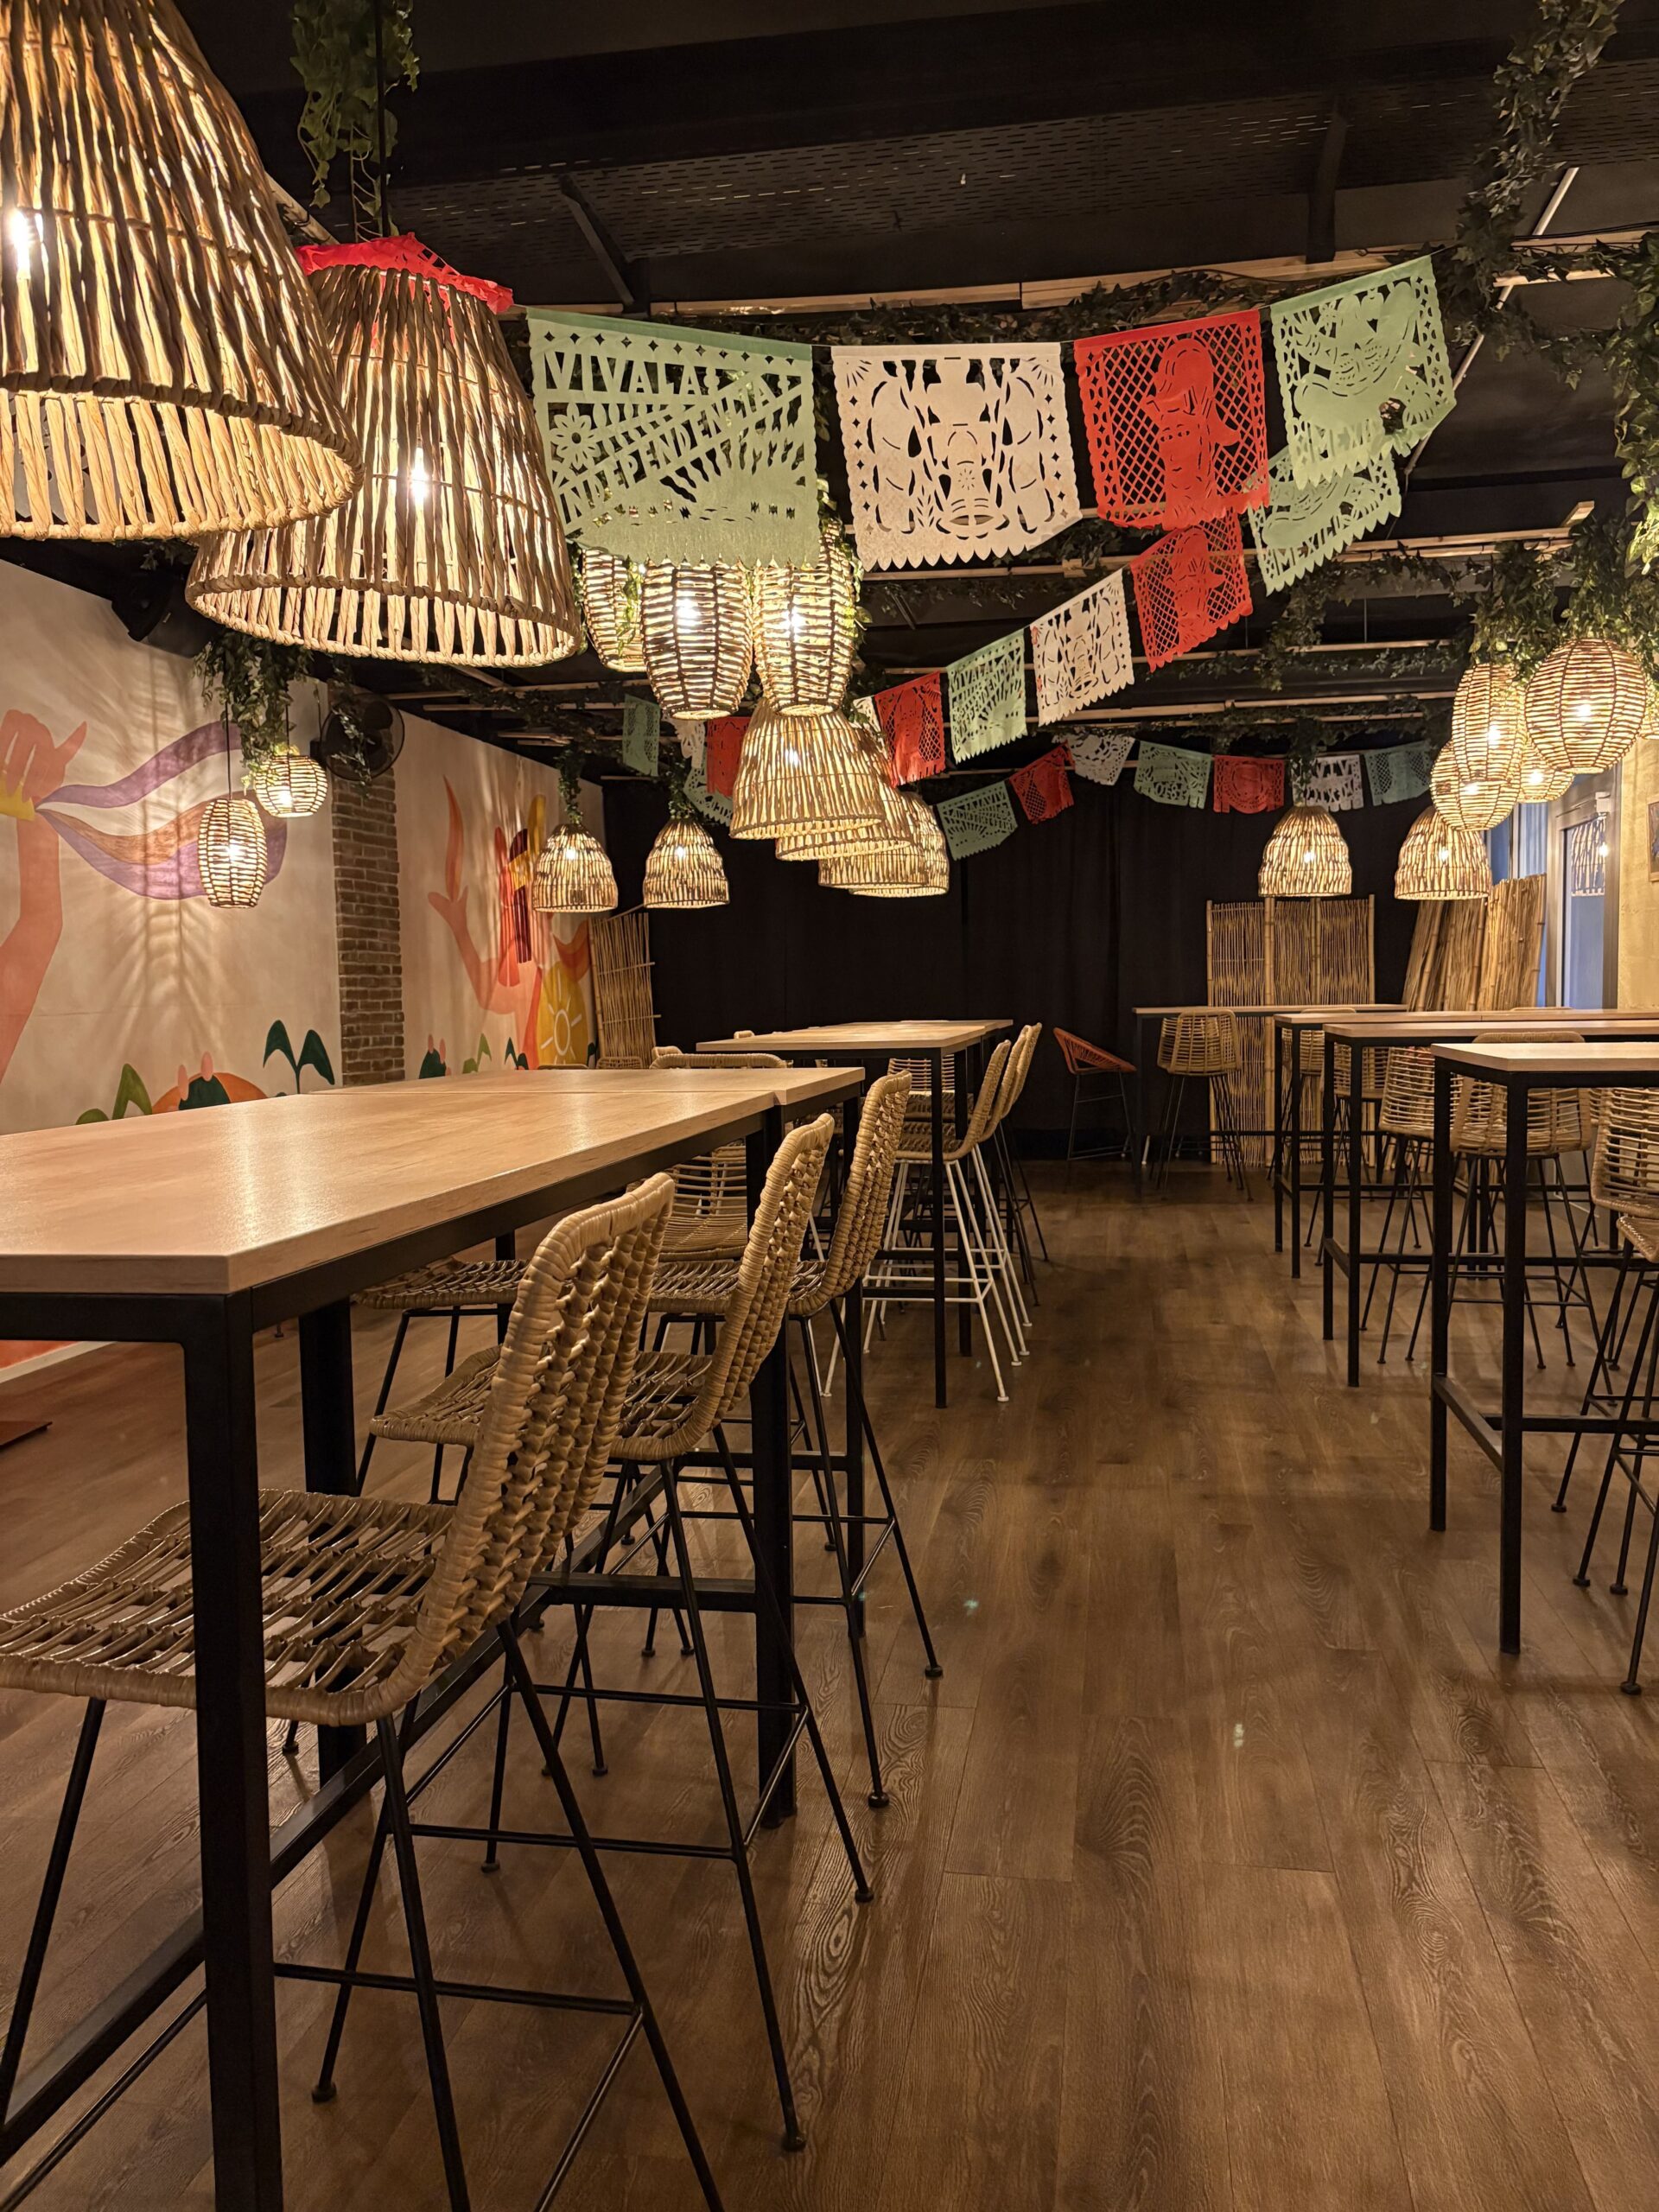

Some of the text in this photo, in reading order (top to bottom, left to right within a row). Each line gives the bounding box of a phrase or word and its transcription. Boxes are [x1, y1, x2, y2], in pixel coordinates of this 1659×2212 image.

[544, 351, 702, 395] VIVA LA
[554, 373, 784, 524] INDEPENDENCIA
[1274, 515, 1344, 575] MEXICO
